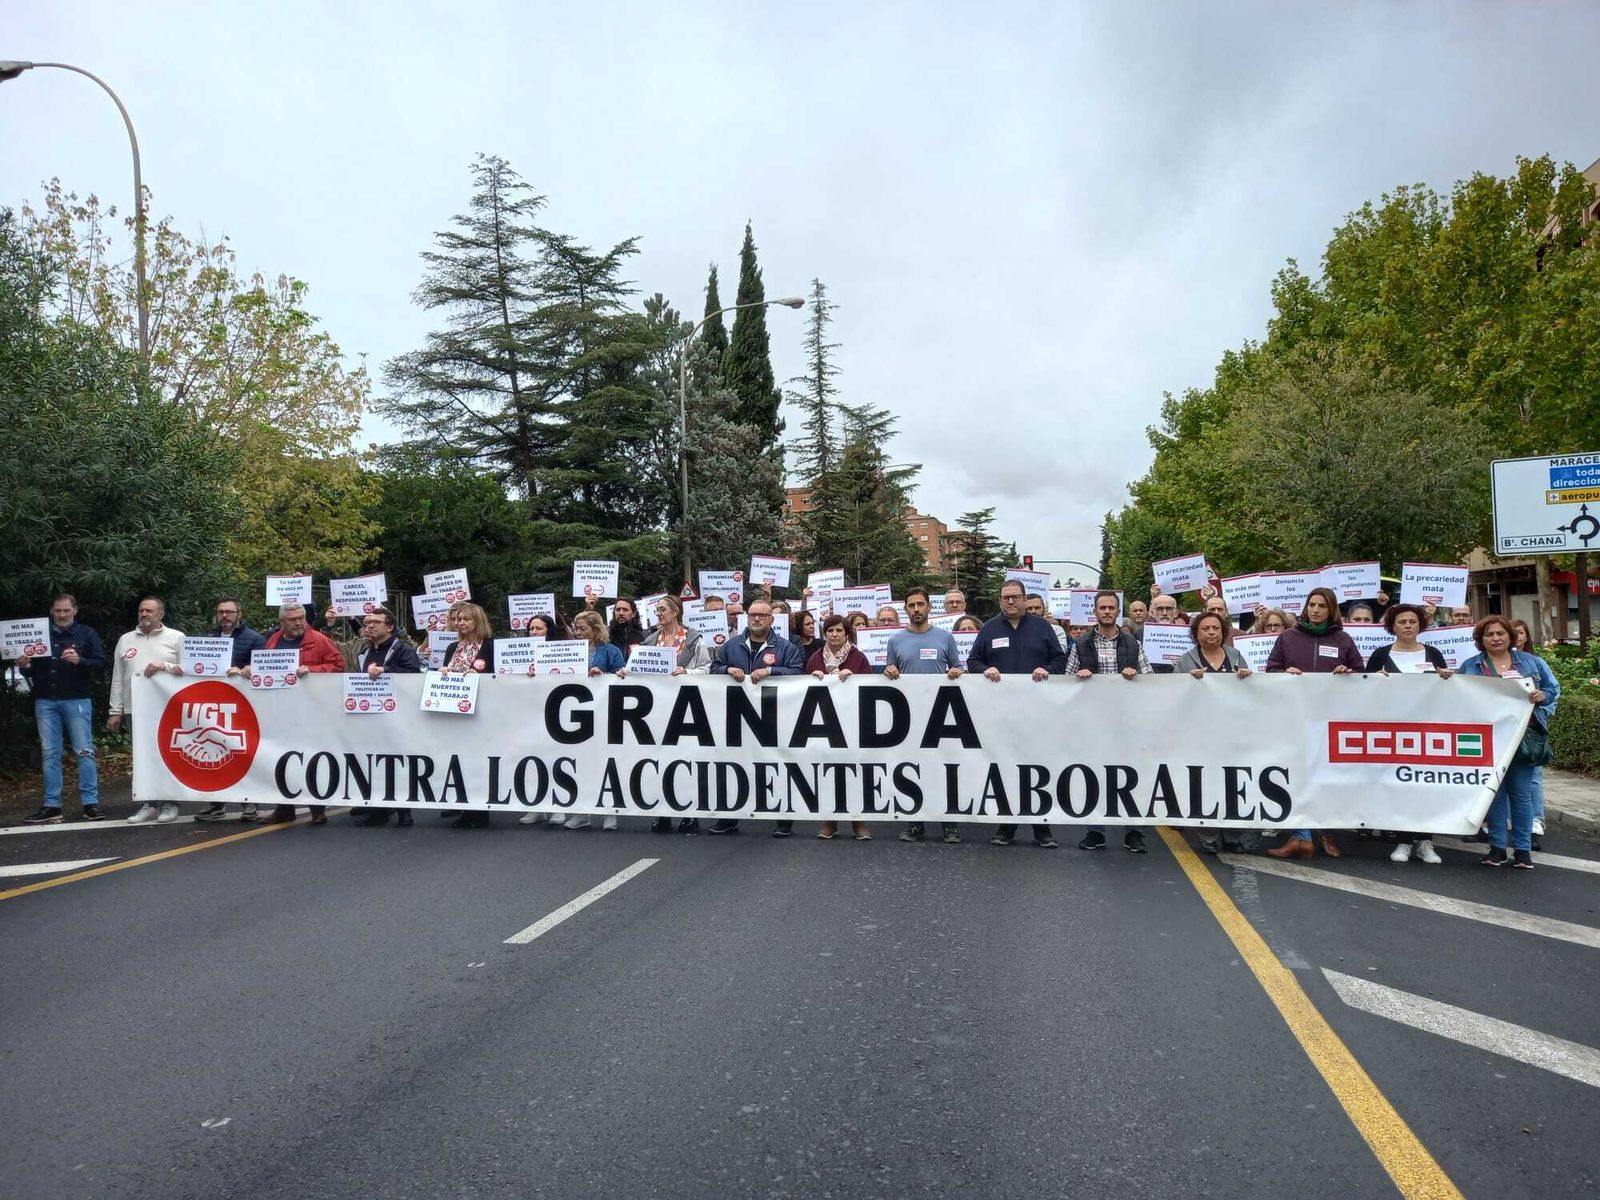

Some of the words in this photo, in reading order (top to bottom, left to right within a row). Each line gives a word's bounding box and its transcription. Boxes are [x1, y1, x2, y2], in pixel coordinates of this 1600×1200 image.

[1520, 536, 1563, 546] CHANA
[1166, 562, 1204, 576] precariedad
[431, 581, 454, 589] MUERTES
[1416, 575, 1465, 583] precariedad
[688, 615, 716, 623] DENUNCIA
[182, 703, 237, 730] UGT
[545, 684, 982, 748] GRANADA
[1338, 731, 1452, 756] CCOO
[275, 751, 468, 803] CONTRA
[487, 756, 577, 807] LOS
[596, 758, 923, 814] ACCIDENTES
[944, 764, 1291, 822] LABORALES
